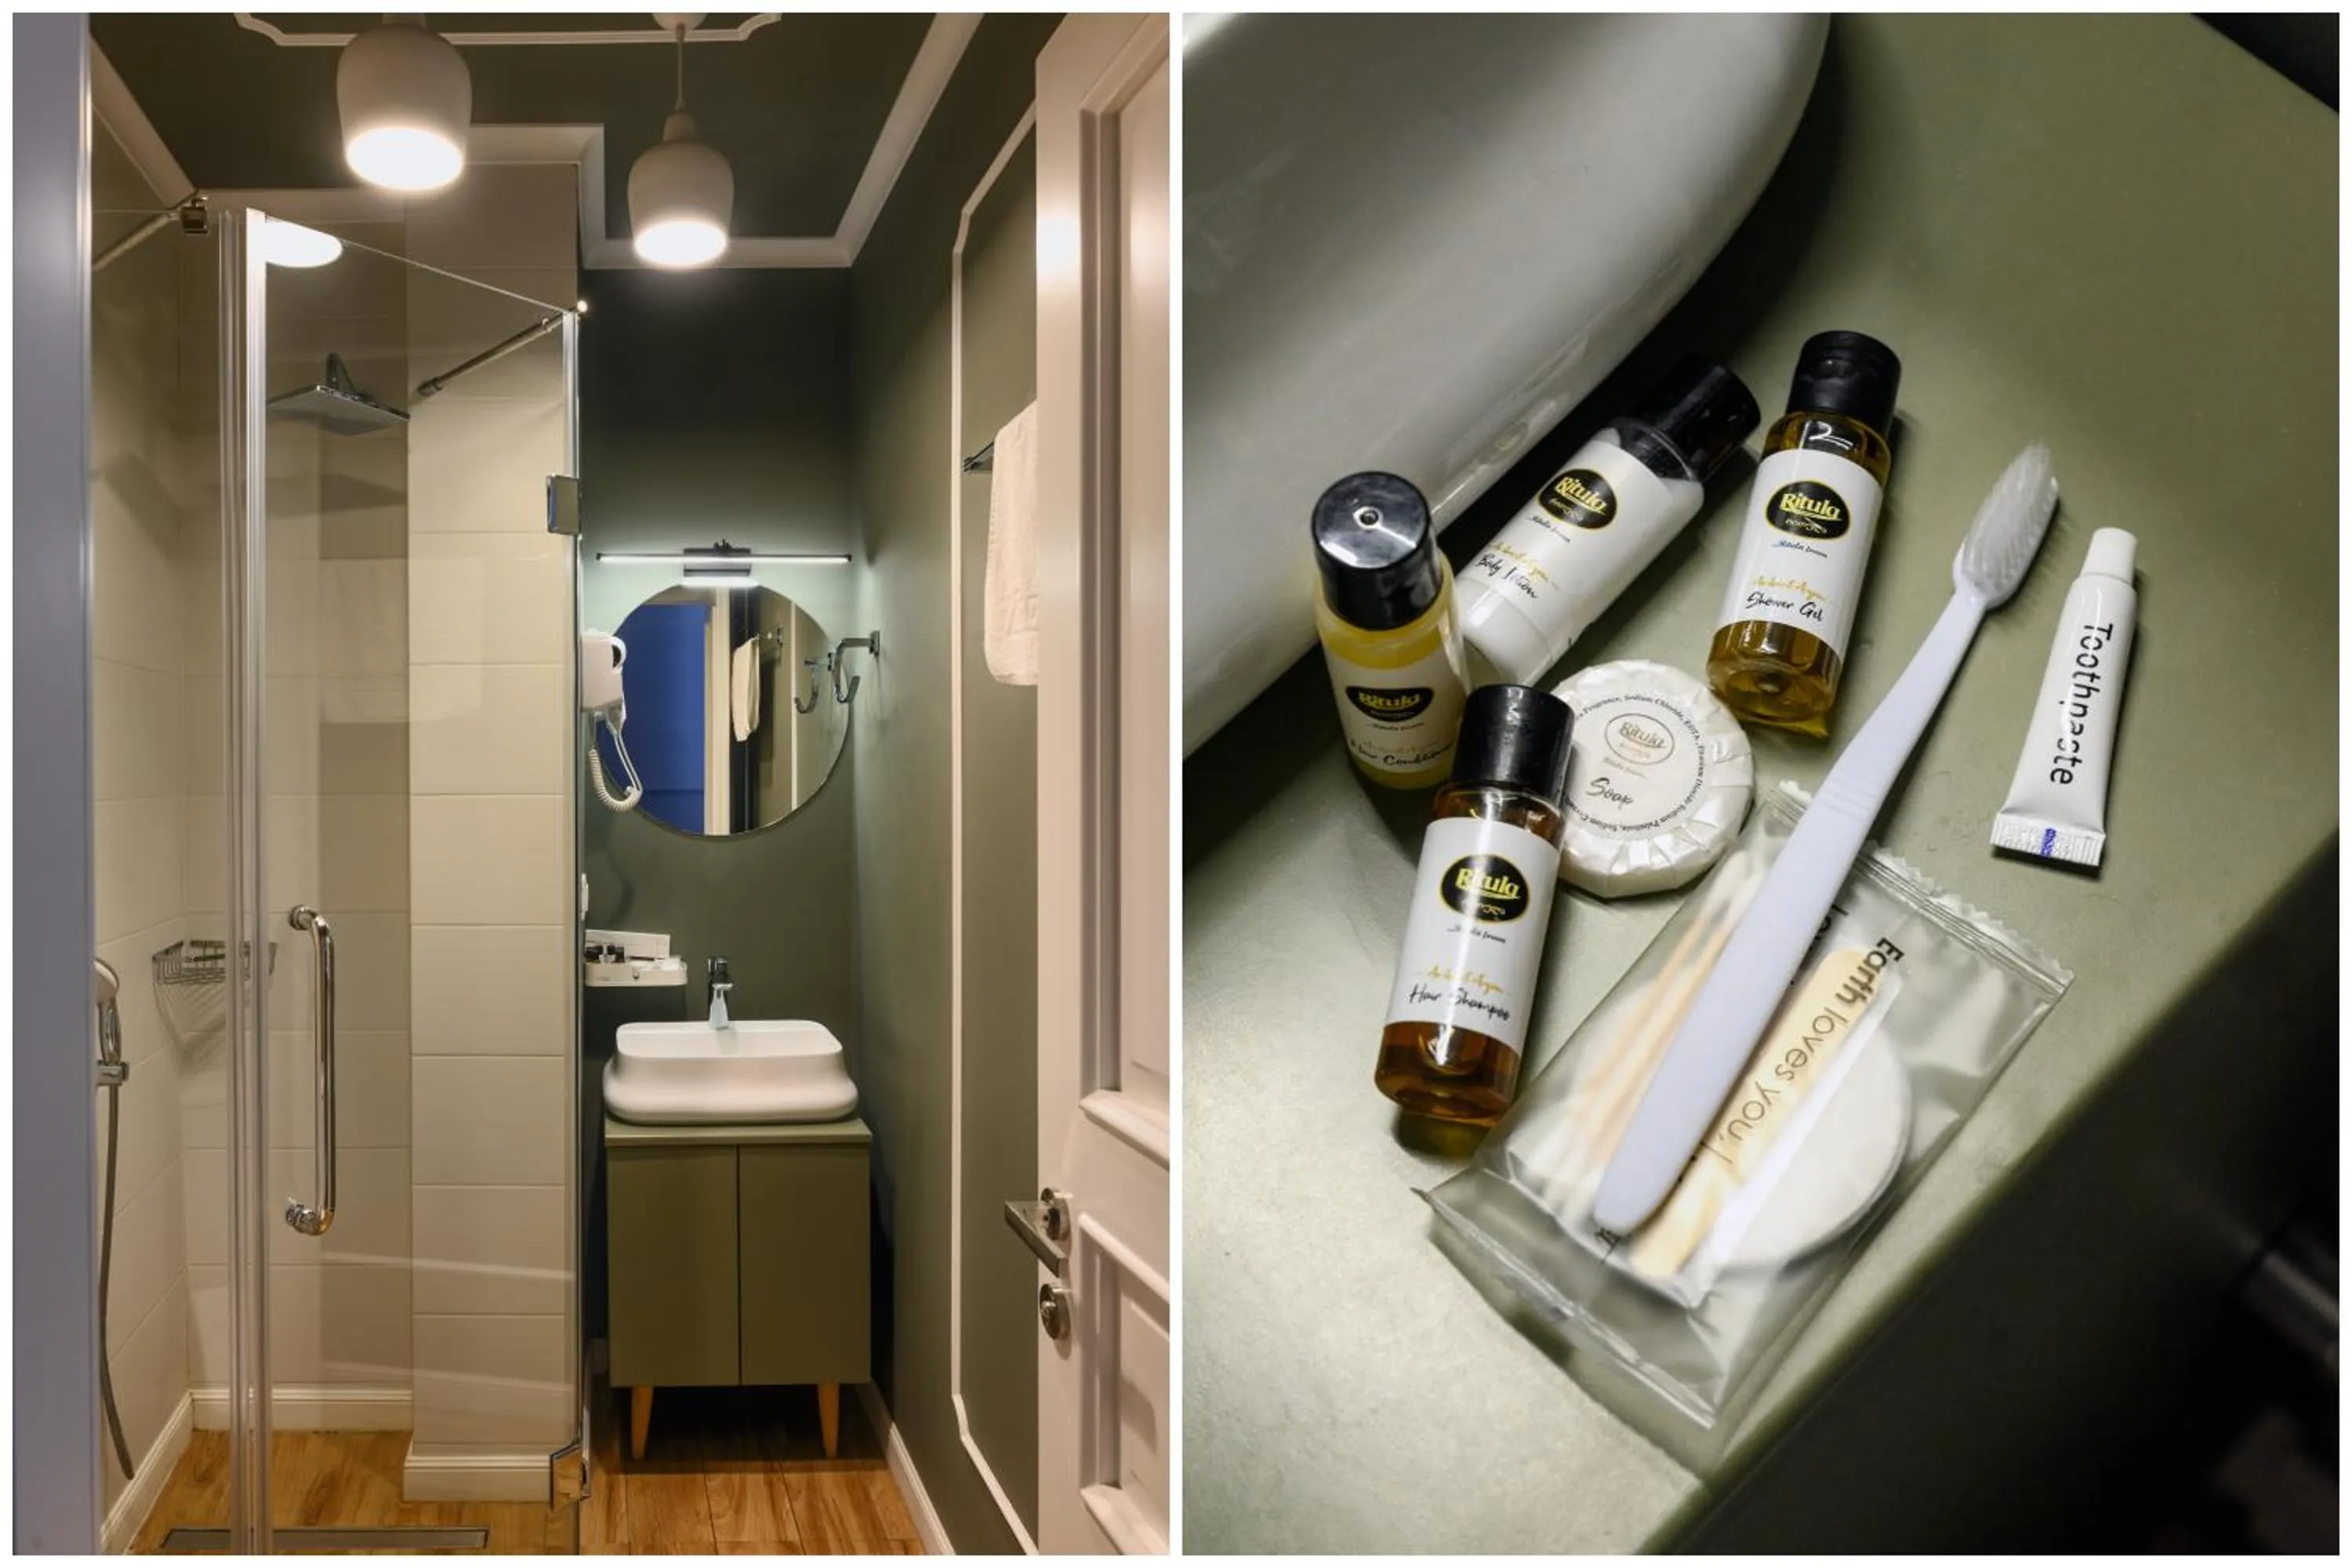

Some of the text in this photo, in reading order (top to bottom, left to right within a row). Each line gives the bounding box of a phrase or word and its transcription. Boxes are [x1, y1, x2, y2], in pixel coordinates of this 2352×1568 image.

[1780, 492, 1841, 521] Ritula
[1745, 591, 1824, 622] Shower Gel
[2050, 623, 2113, 785] Toothpaste
[1585, 777, 1634, 810] Soap
[1409, 983, 1442, 1004] Hair
[1836, 937, 1905, 1004] Earth
[1774, 1006, 1849, 1081] loves
[1719, 1081, 1781, 1142] you,
